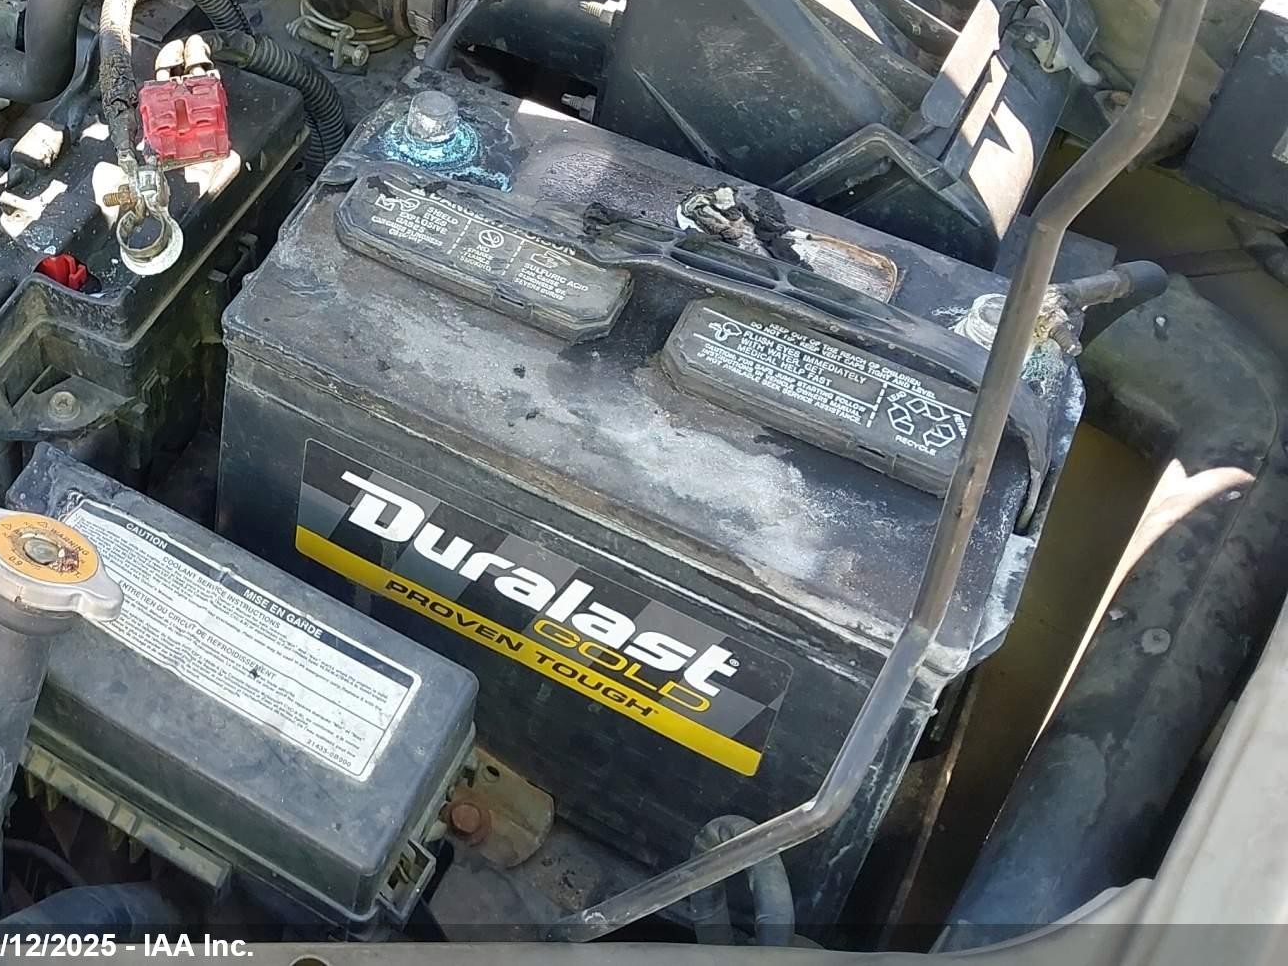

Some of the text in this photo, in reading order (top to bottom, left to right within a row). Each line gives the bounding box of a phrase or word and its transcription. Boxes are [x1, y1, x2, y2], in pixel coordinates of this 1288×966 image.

[398, 211, 448, 234] EXPLOSIVE
[425, 205, 459, 224] SHIELD
[476, 244, 489, 252] NO
[523, 262, 589, 291] SULFURIC ACID
[736, 344, 832, 386] MEDICAL HELP FAST
[740, 336, 766, 352] WITH
[804, 362, 824, 375] GET
[742, 330, 867, 385] FLUSH EYES IMMEDIATELY
[895, 434, 937, 456] RECYCLE
[124, 521, 169, 550] CAUTION
[161, 555, 197, 579] COOLANT
[225, 593, 281, 629] INSTRUCTIONS
[341, 471, 739, 698] Duralast
[155, 603, 168, 615] DU
[194, 628, 207, 639] DE
[242, 588, 324, 639] MISE EN GARDE
[383, 579, 654, 719] PROVEN TOUGH
[531, 618, 712, 714] GOLD
